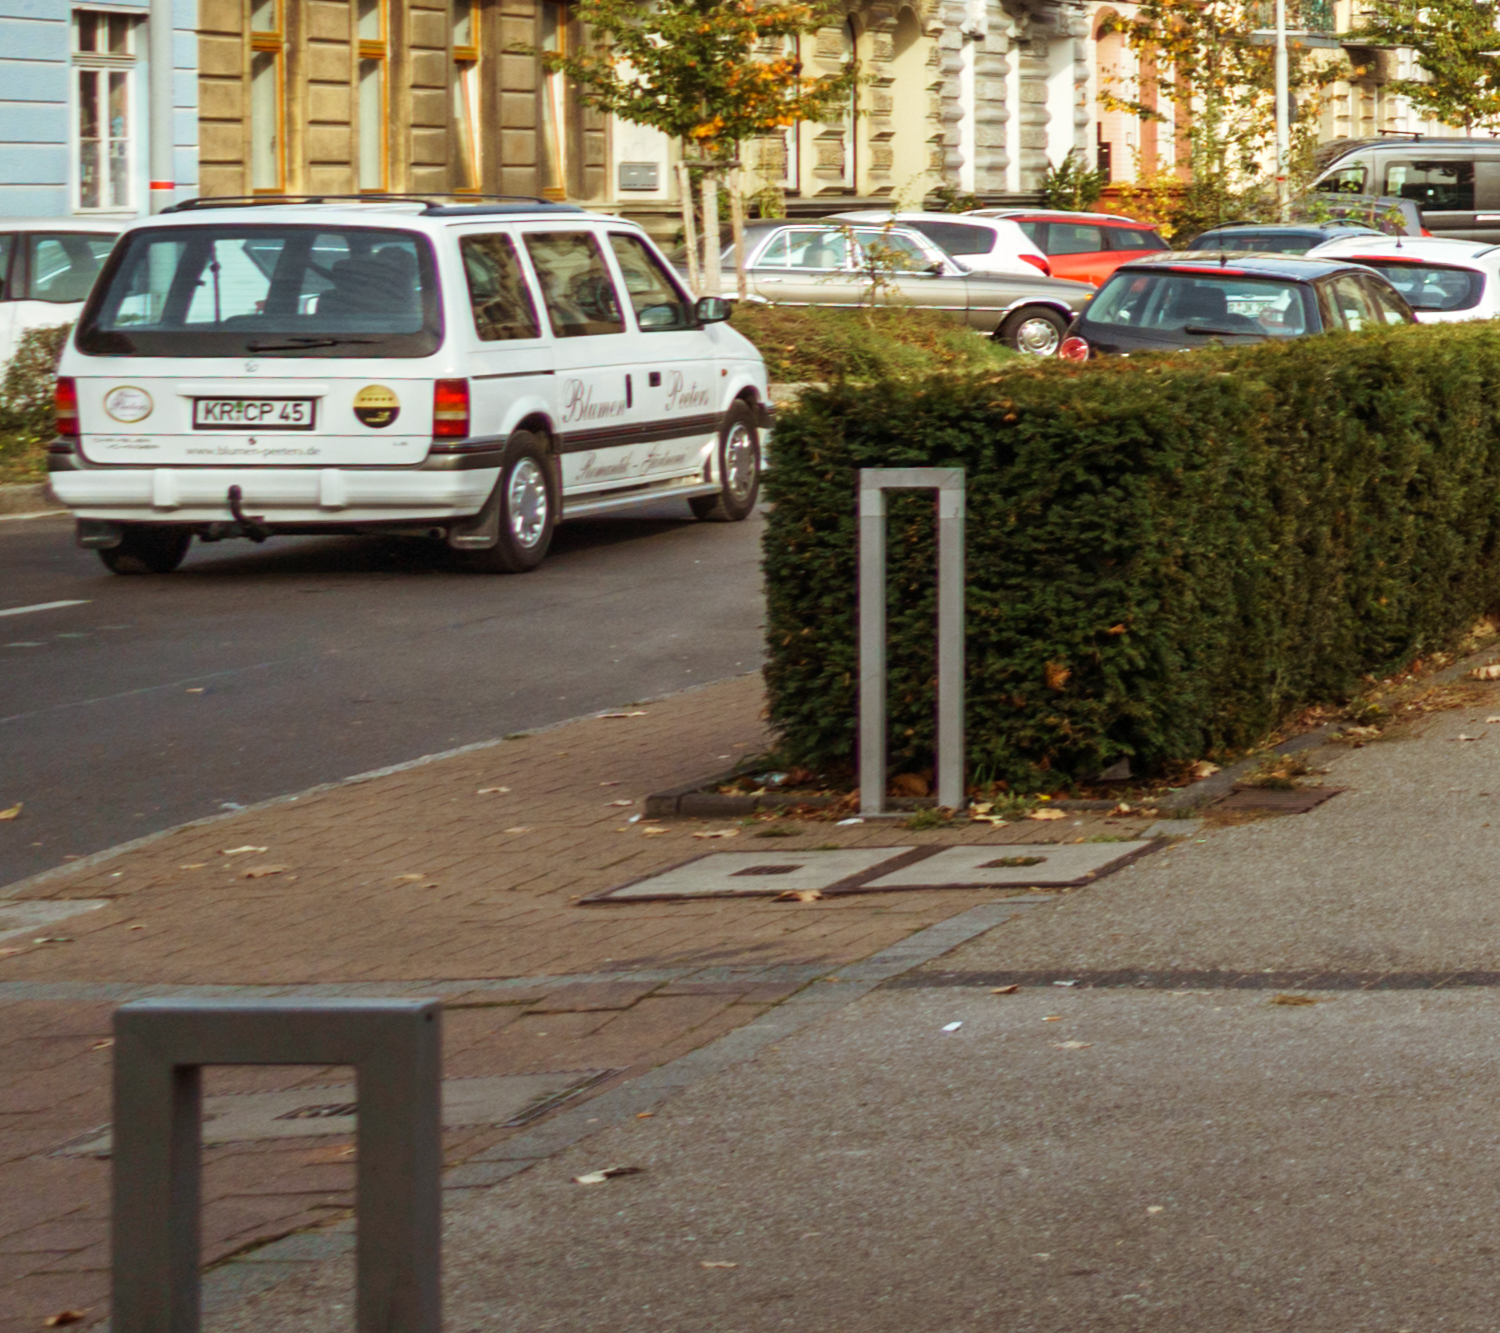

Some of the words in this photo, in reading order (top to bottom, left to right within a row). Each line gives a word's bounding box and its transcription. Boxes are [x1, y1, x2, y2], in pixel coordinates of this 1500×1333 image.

[279, 402, 304, 422] 45
[562, 378, 626, 424] Blumen
[665, 369, 709, 411] Peeters
